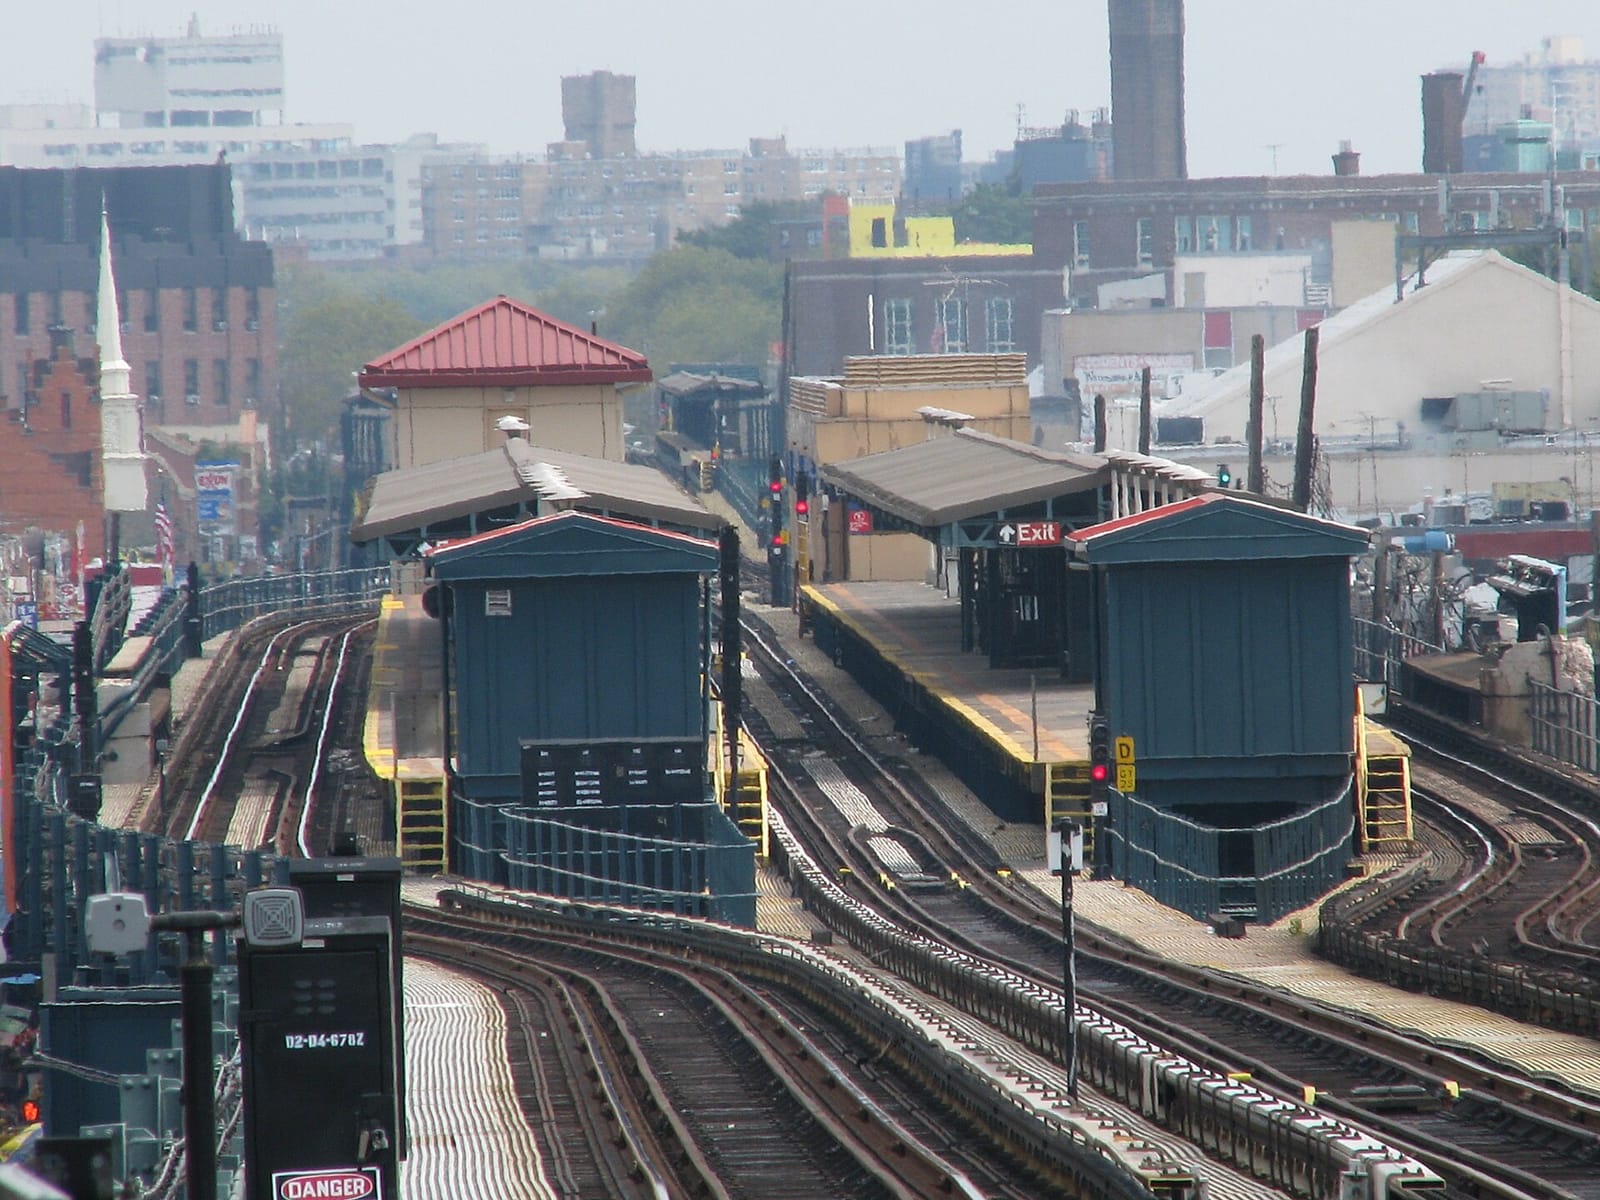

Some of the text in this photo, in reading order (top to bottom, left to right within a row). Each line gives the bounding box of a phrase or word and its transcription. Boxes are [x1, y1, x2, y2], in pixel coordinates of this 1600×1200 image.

[1018, 523, 1056, 541] Exit
[1119, 743, 1131, 758] D
[288, 1178, 365, 1199] DANGER
